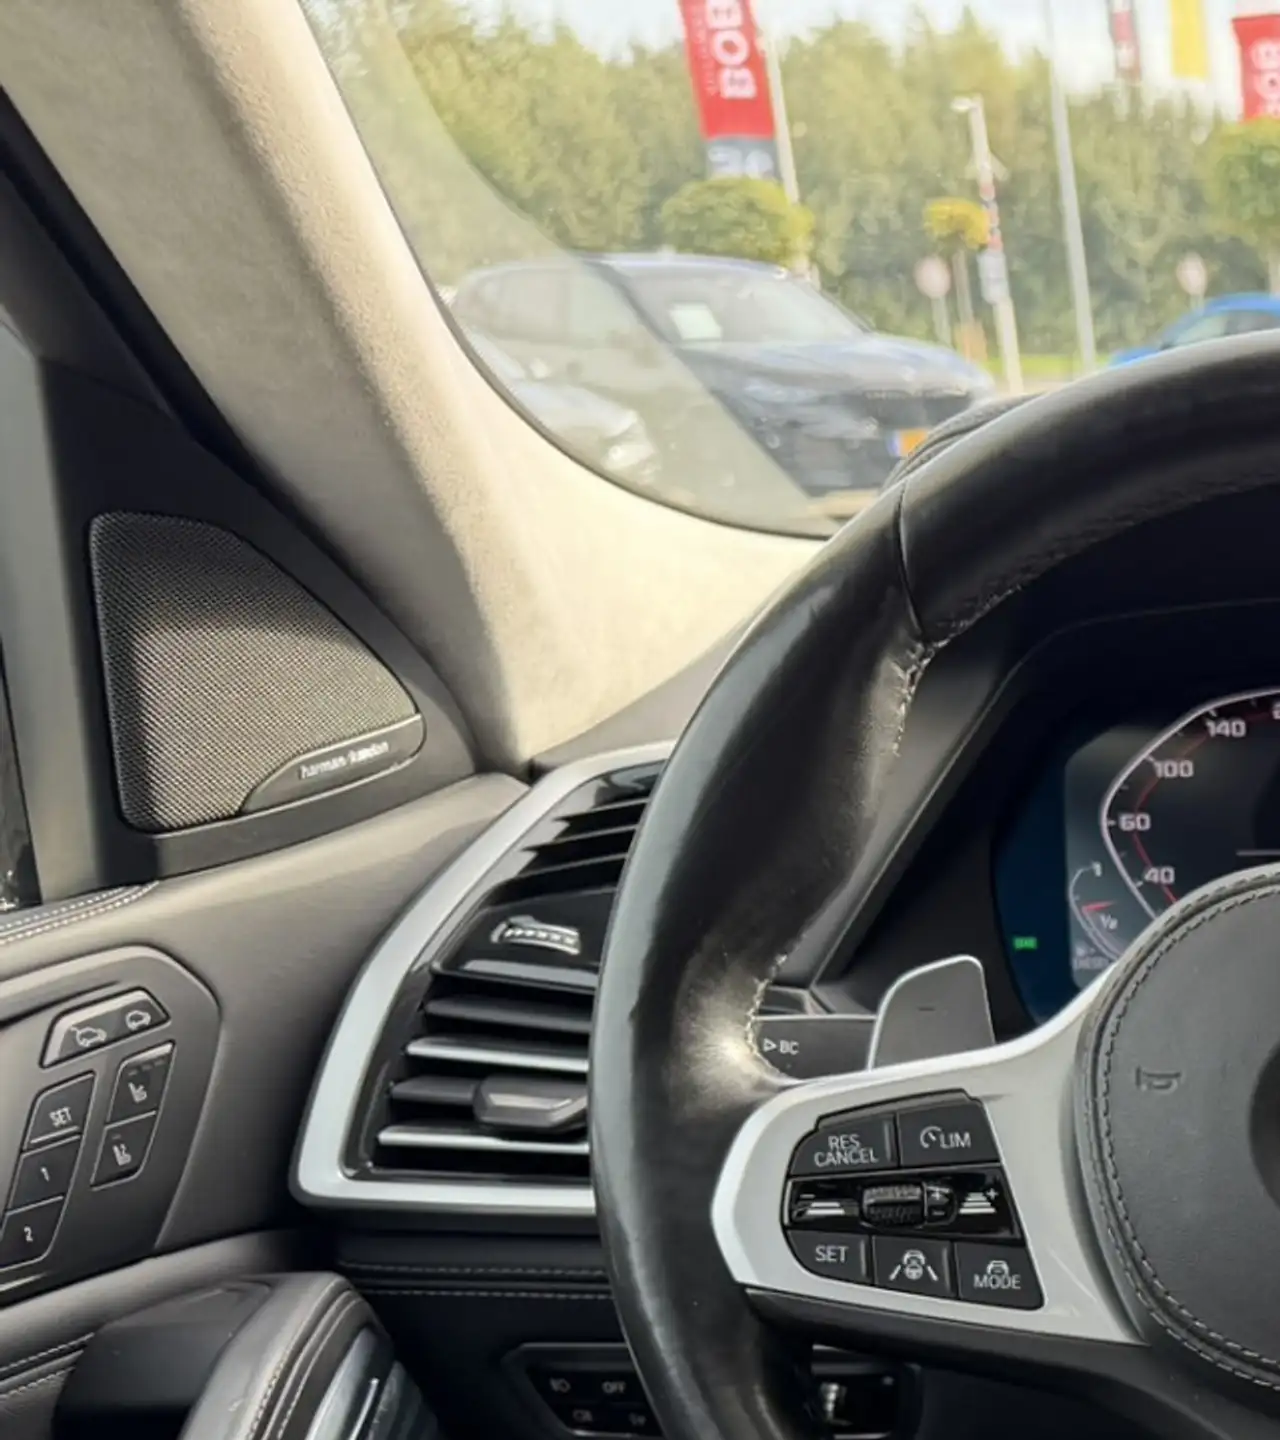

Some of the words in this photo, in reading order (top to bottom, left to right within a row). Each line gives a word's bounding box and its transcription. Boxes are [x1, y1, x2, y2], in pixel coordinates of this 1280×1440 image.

[1206, 720, 1246, 738] 140
[1154, 760, 1195, 778] 100
[1119, 814, 1152, 832] 60
[1143, 867, 1175, 884] 40
[48, 1106, 73, 1128] SET
[827, 1133, 861, 1151] RES
[939, 1131, 972, 1150] LIM
[813, 1150, 879, 1168] CANCEL
[23, 1226, 34, 1243] 2
[814, 1245, 849, 1264] SET
[973, 1274, 1022, 1291] MODE
